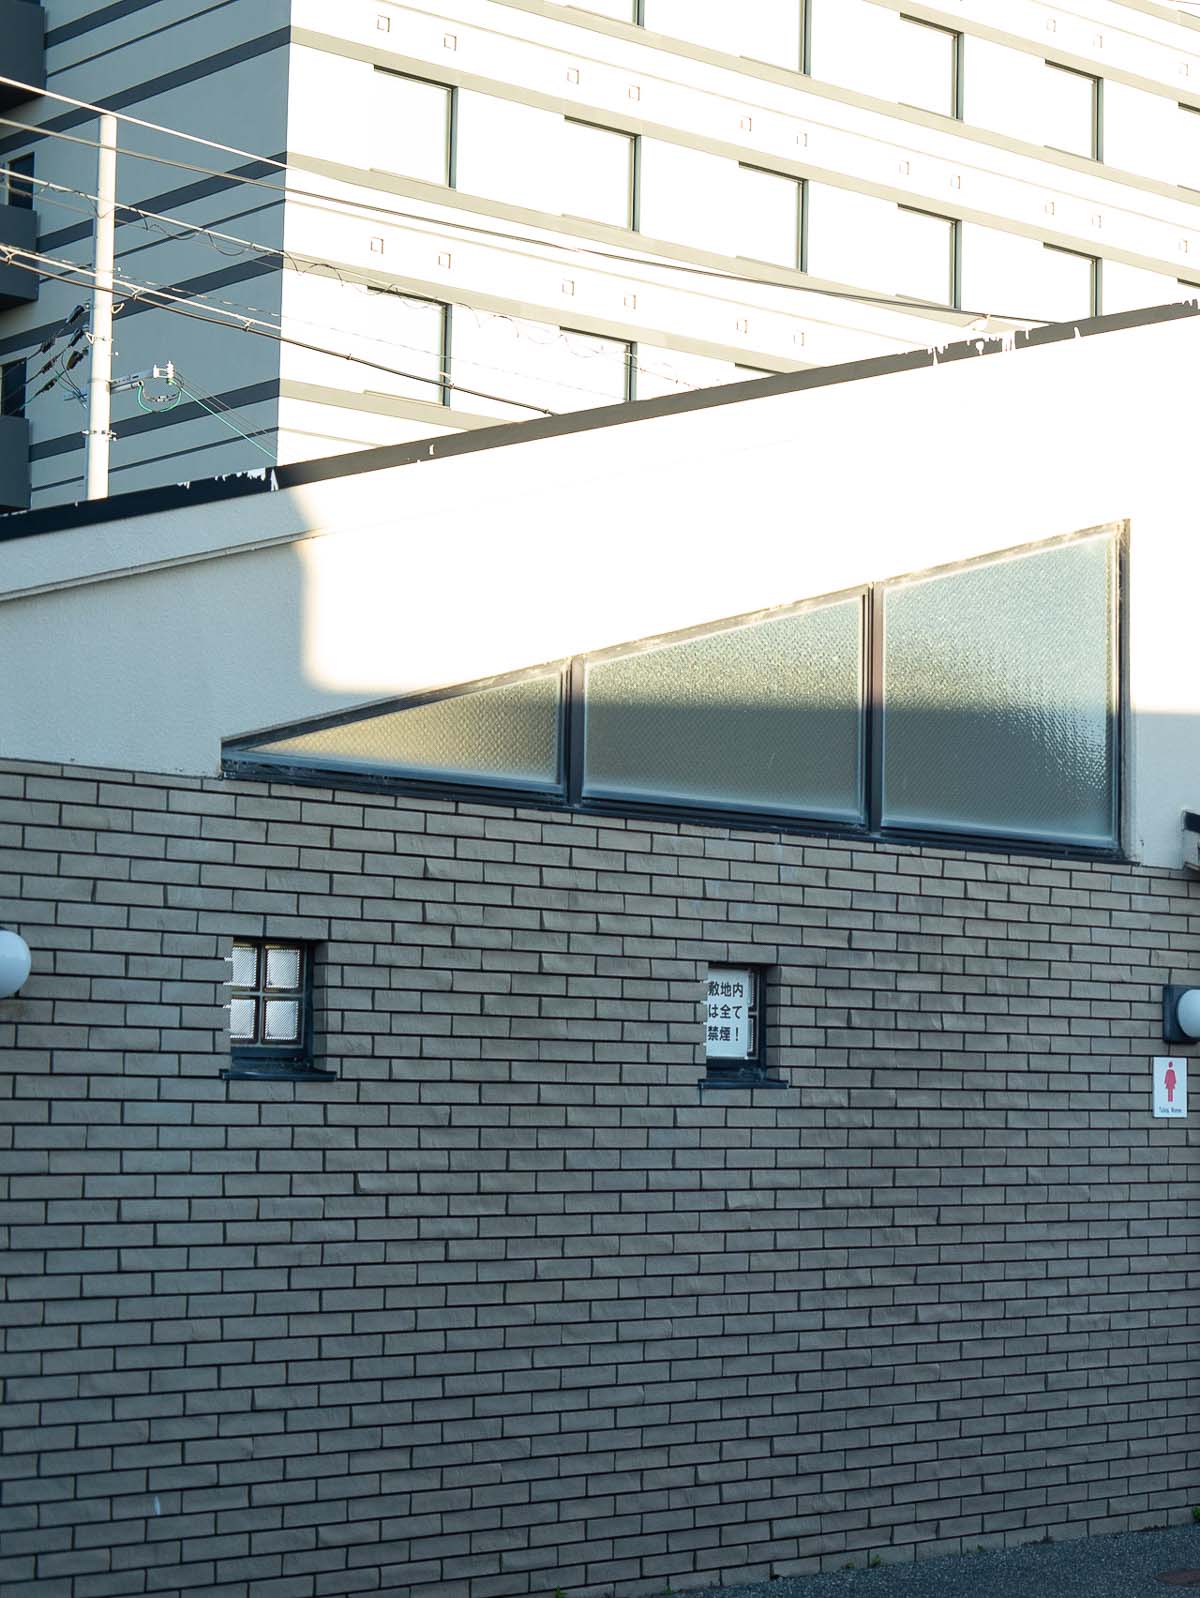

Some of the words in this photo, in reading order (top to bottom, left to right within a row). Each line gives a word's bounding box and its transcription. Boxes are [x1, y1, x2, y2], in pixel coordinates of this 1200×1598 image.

[708, 981, 744, 998] 敷地内
[708, 1003, 743, 1019] は全て
[707, 1025, 739, 1041] 禁煙！
